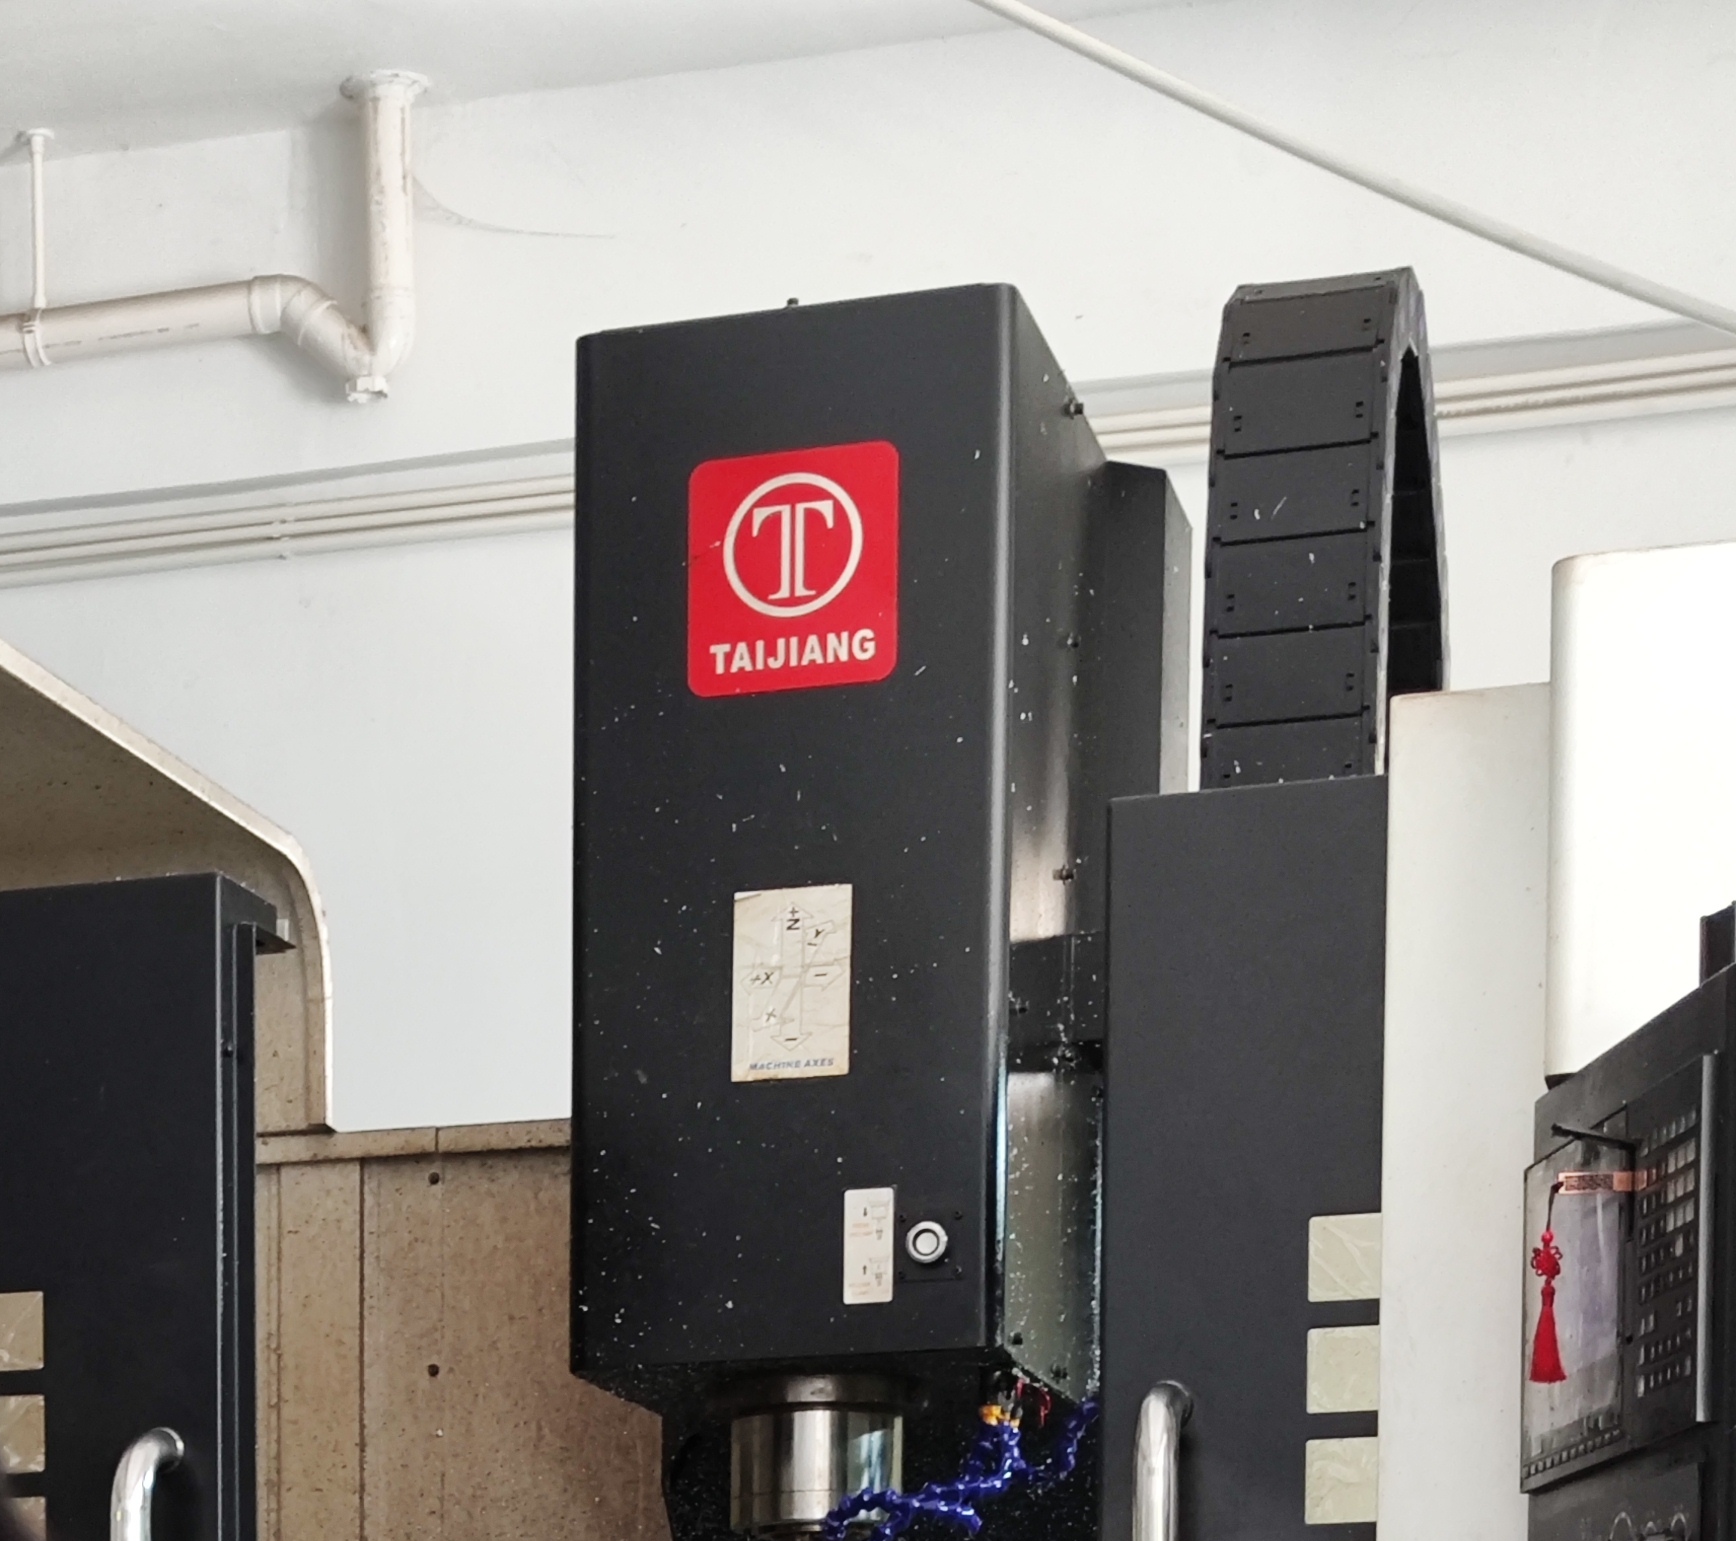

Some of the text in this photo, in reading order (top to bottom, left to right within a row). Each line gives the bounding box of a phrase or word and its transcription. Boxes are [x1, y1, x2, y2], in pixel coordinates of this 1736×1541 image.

[709, 628, 876, 675] TAIJIANG
[749, 1057, 834, 1071] MACHINE AXES
